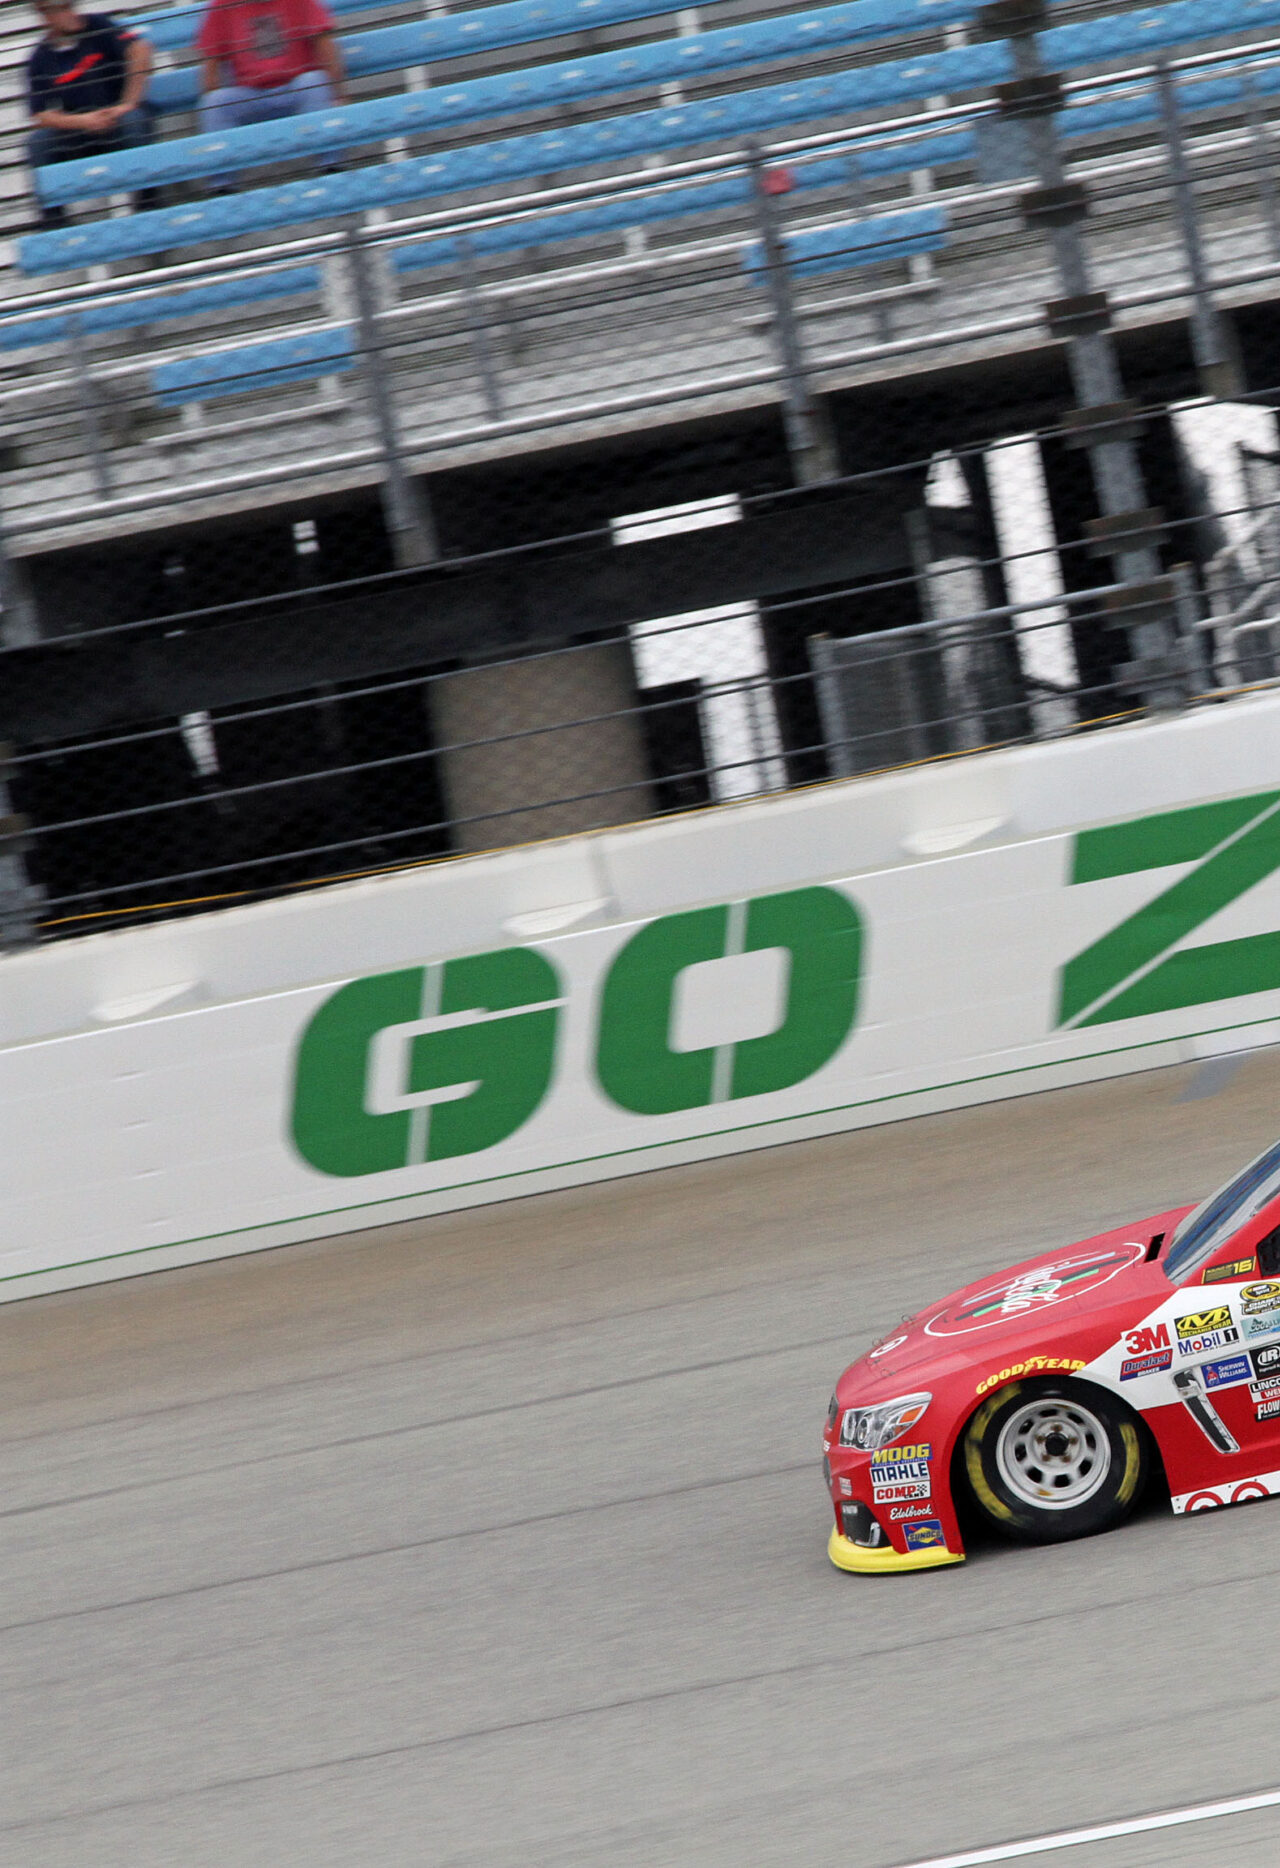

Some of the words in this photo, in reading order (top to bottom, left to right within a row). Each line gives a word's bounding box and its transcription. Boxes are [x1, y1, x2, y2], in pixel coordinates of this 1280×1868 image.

[292, 886, 864, 1177] GO
[1233, 1259, 1253, 1274] 16
[1125, 1323, 1171, 1354] 3M
[1178, 1331, 1221, 1355] Mobil
[1123, 1351, 1170, 1373] Duralast
[1260, 1348, 1280, 1363] IR
[976, 1355, 1087, 1395] GOODYEAR
[871, 1443, 931, 1464] MOOG
[870, 1462, 928, 1482] MAHLE
[876, 1485, 917, 1501] COMP
[889, 1503, 933, 1520] Edelbrock
[908, 1529, 944, 1541] SUNOCO
